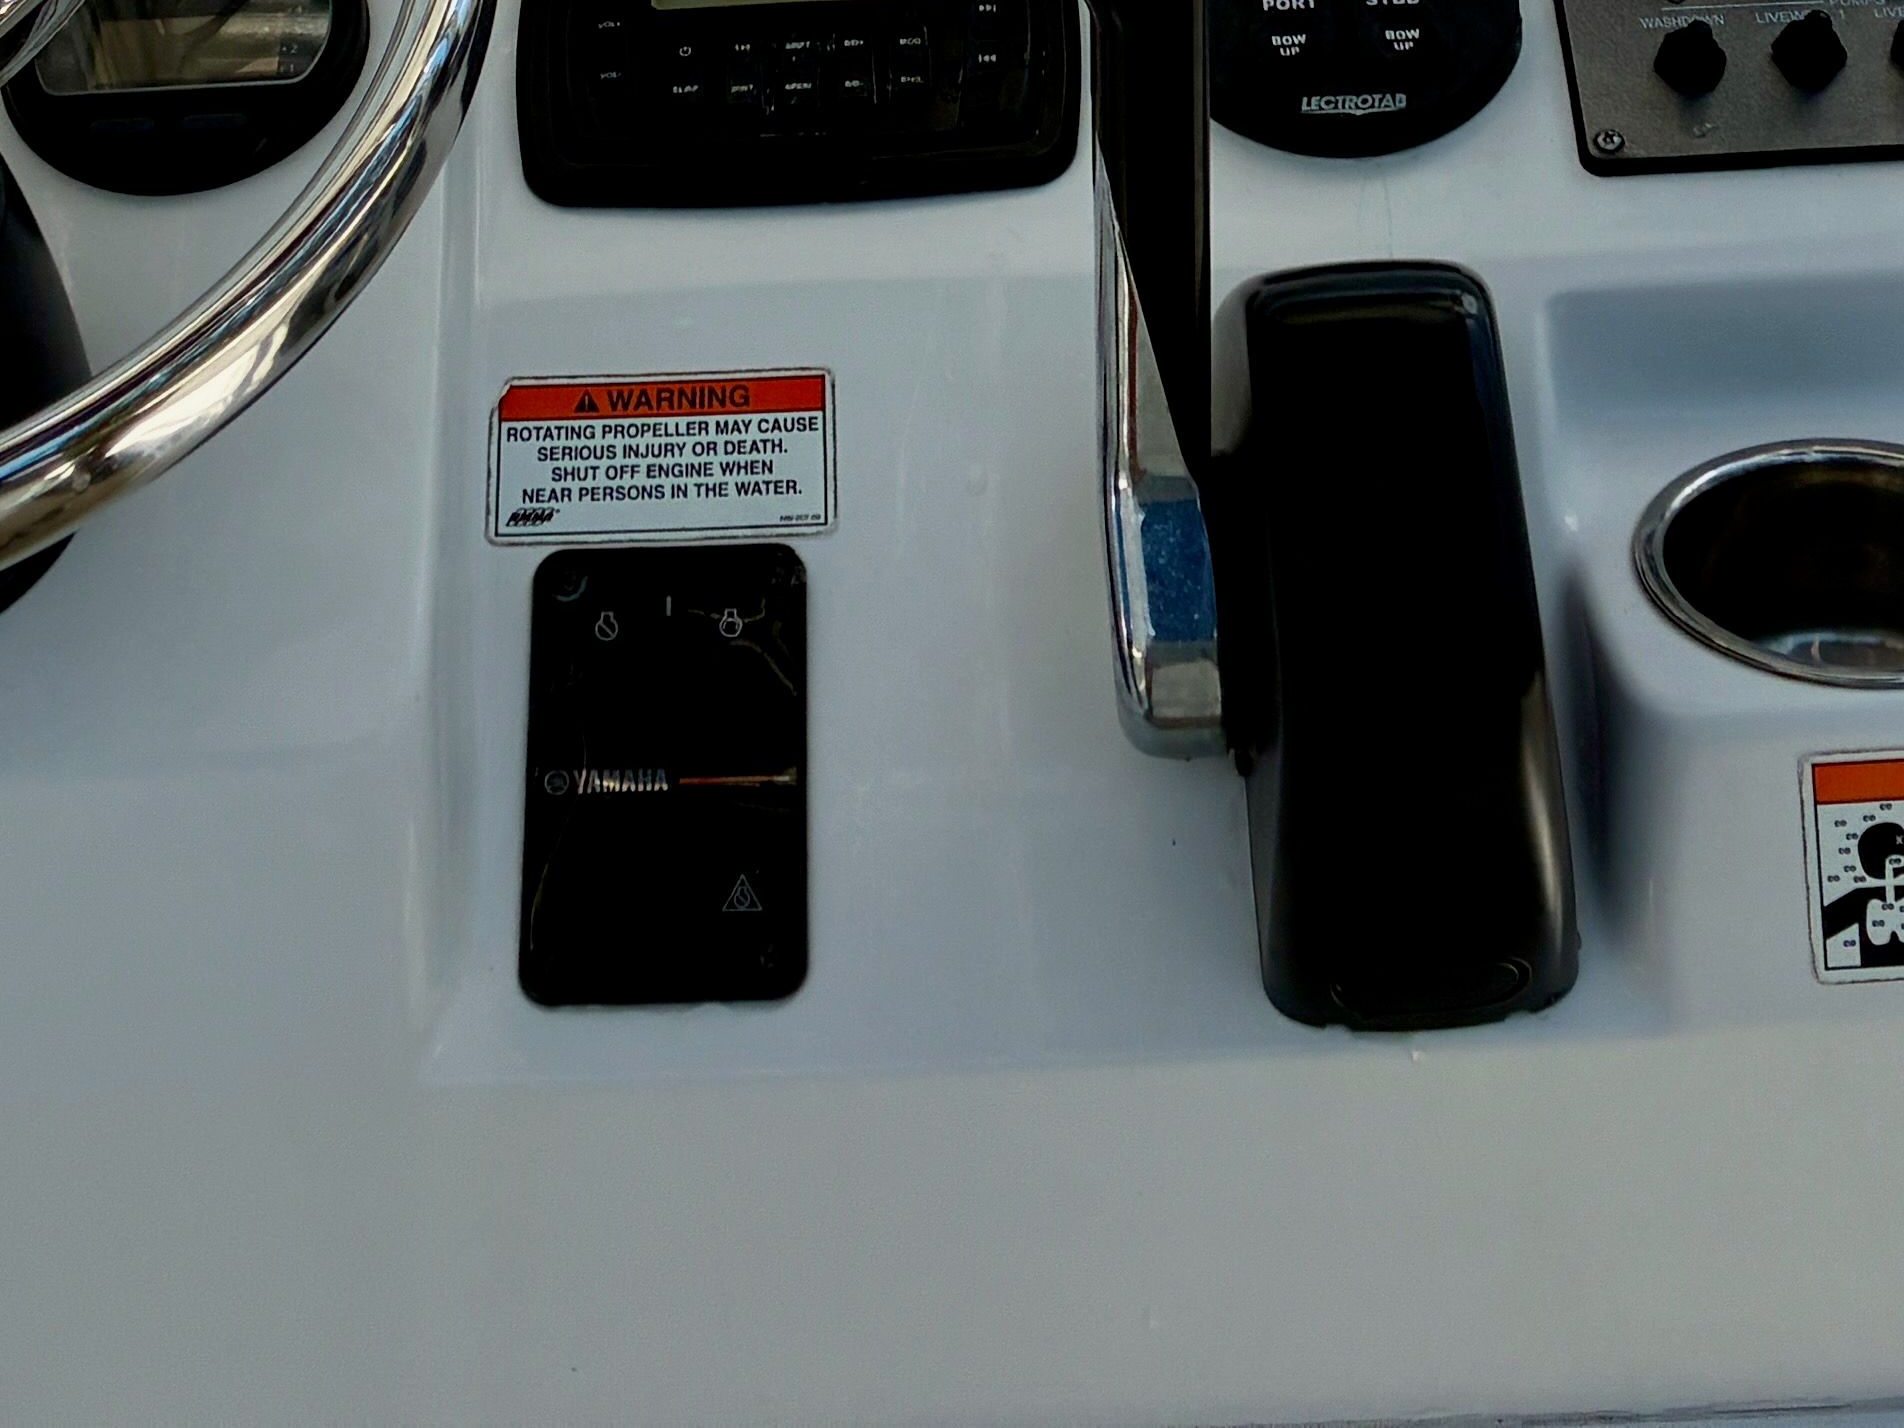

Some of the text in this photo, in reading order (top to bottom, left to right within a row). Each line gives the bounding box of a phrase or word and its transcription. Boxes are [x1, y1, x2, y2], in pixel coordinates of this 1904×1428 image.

[1639, 14, 1724, 29] WASHDOWN
[1272, 33, 1306, 46] BOW
[1385, 28, 1420, 41] BOW
[1393, 40, 1414, 51] UP
[1280, 46, 1300, 57] UP
[1301, 93, 1407, 114] LECTROTAB
[607, 385, 751, 413] WARNING
[506, 416, 819, 442] ROTATING PROPELLER MAY CAUSE
[537, 438, 788, 462] SERIOUS INJURY OR DEATH.
[551, 459, 773, 483] SHUT OFF ENGINE WHEN
[522, 479, 802, 505] NEAR PERSONS IN THE WATER.
[573, 768, 669, 795] YAMAHA
